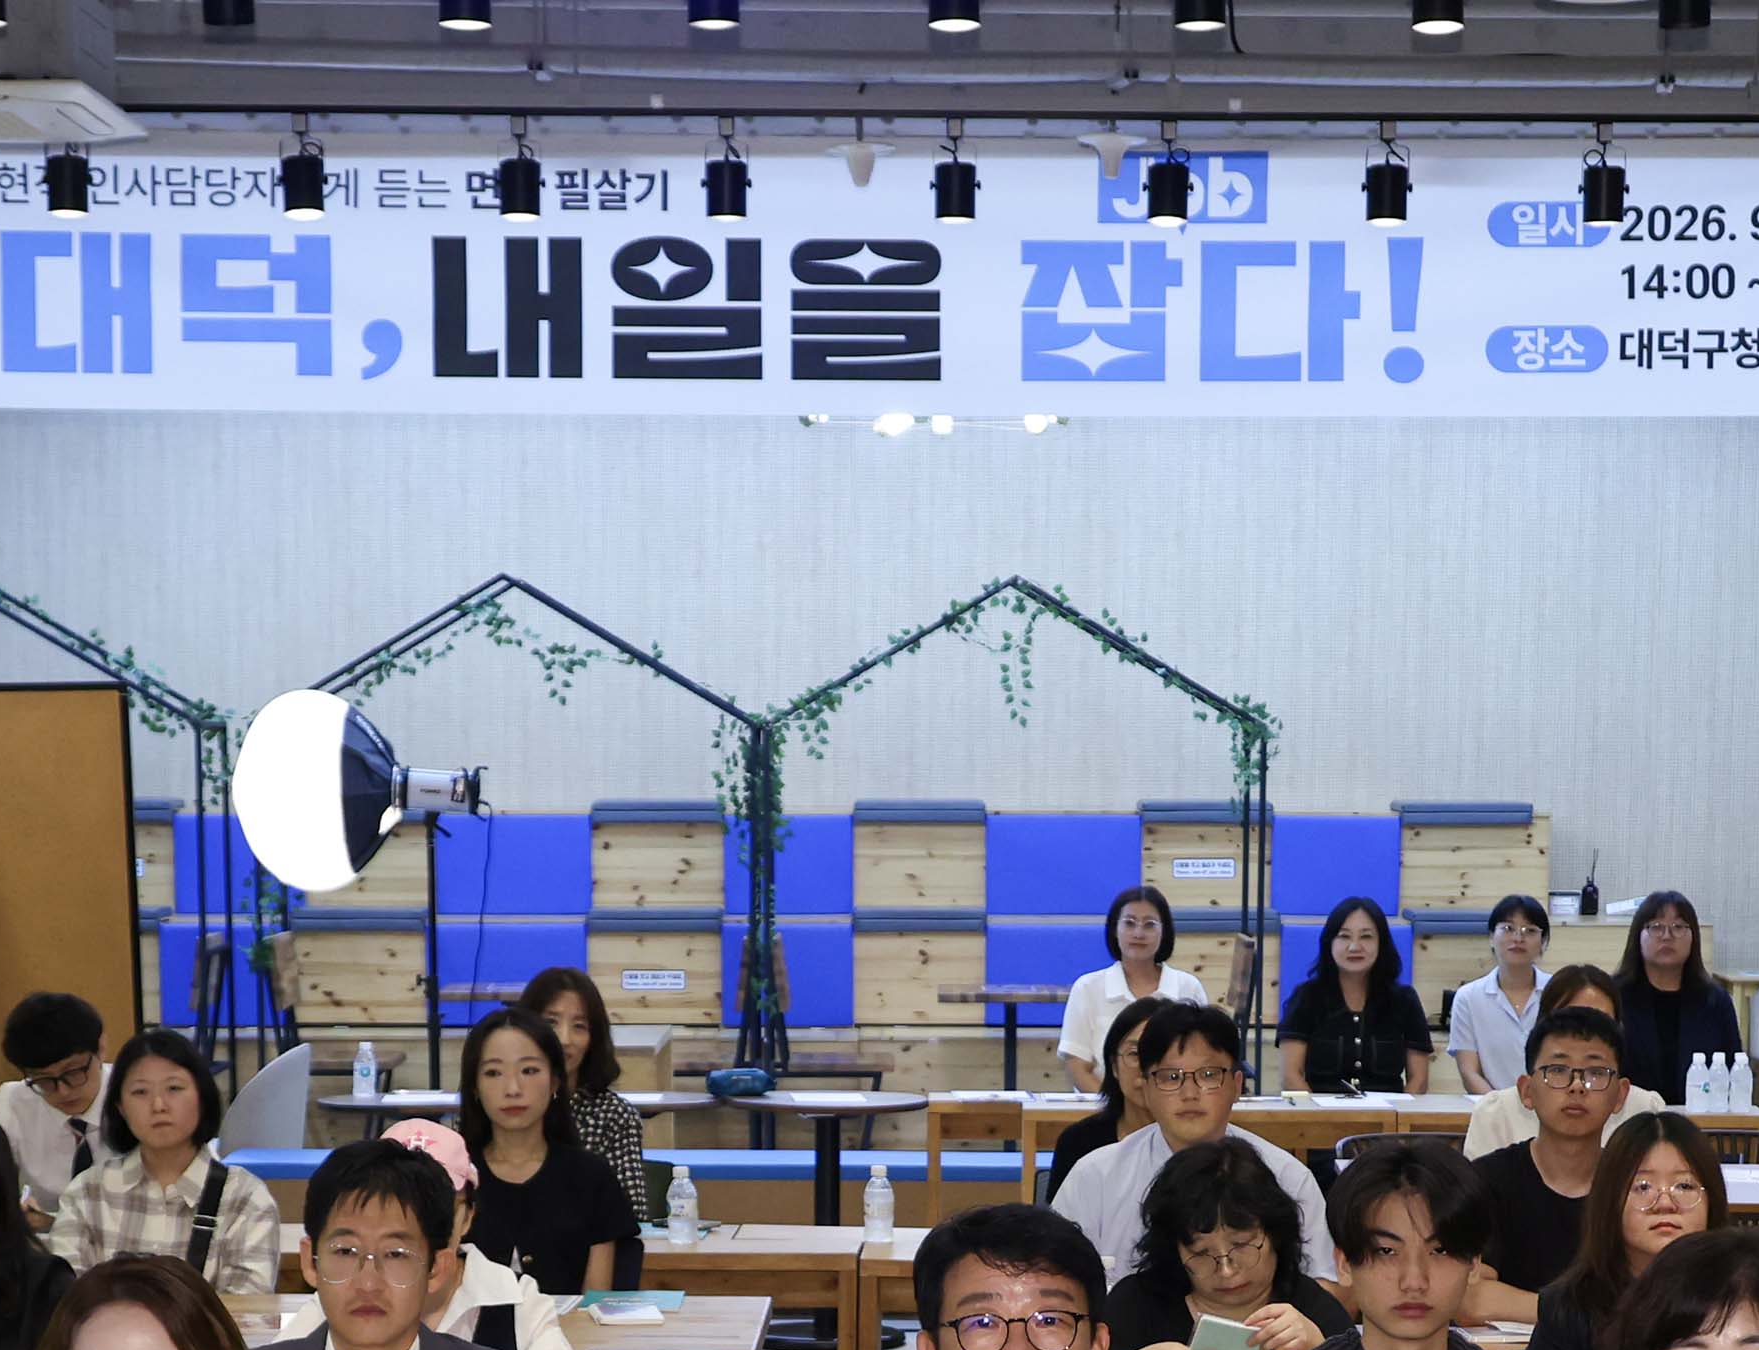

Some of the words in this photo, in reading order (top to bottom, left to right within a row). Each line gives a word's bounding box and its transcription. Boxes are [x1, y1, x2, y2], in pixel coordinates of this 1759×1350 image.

[89, 164, 358, 208] 인사담당자게
[374, 167, 451, 208] 듣는
[555, 168, 668, 211] 필살기
[1112, 155, 1254, 218] Jb
[1512, 202, 1584, 245] 일시
[1620, 205, 1736, 241] 2026.
[1621, 264, 1736, 299] 14:00
[1021, 236, 1425, 383] 잡다!
[1512, 329, 1586, 370] 장소
